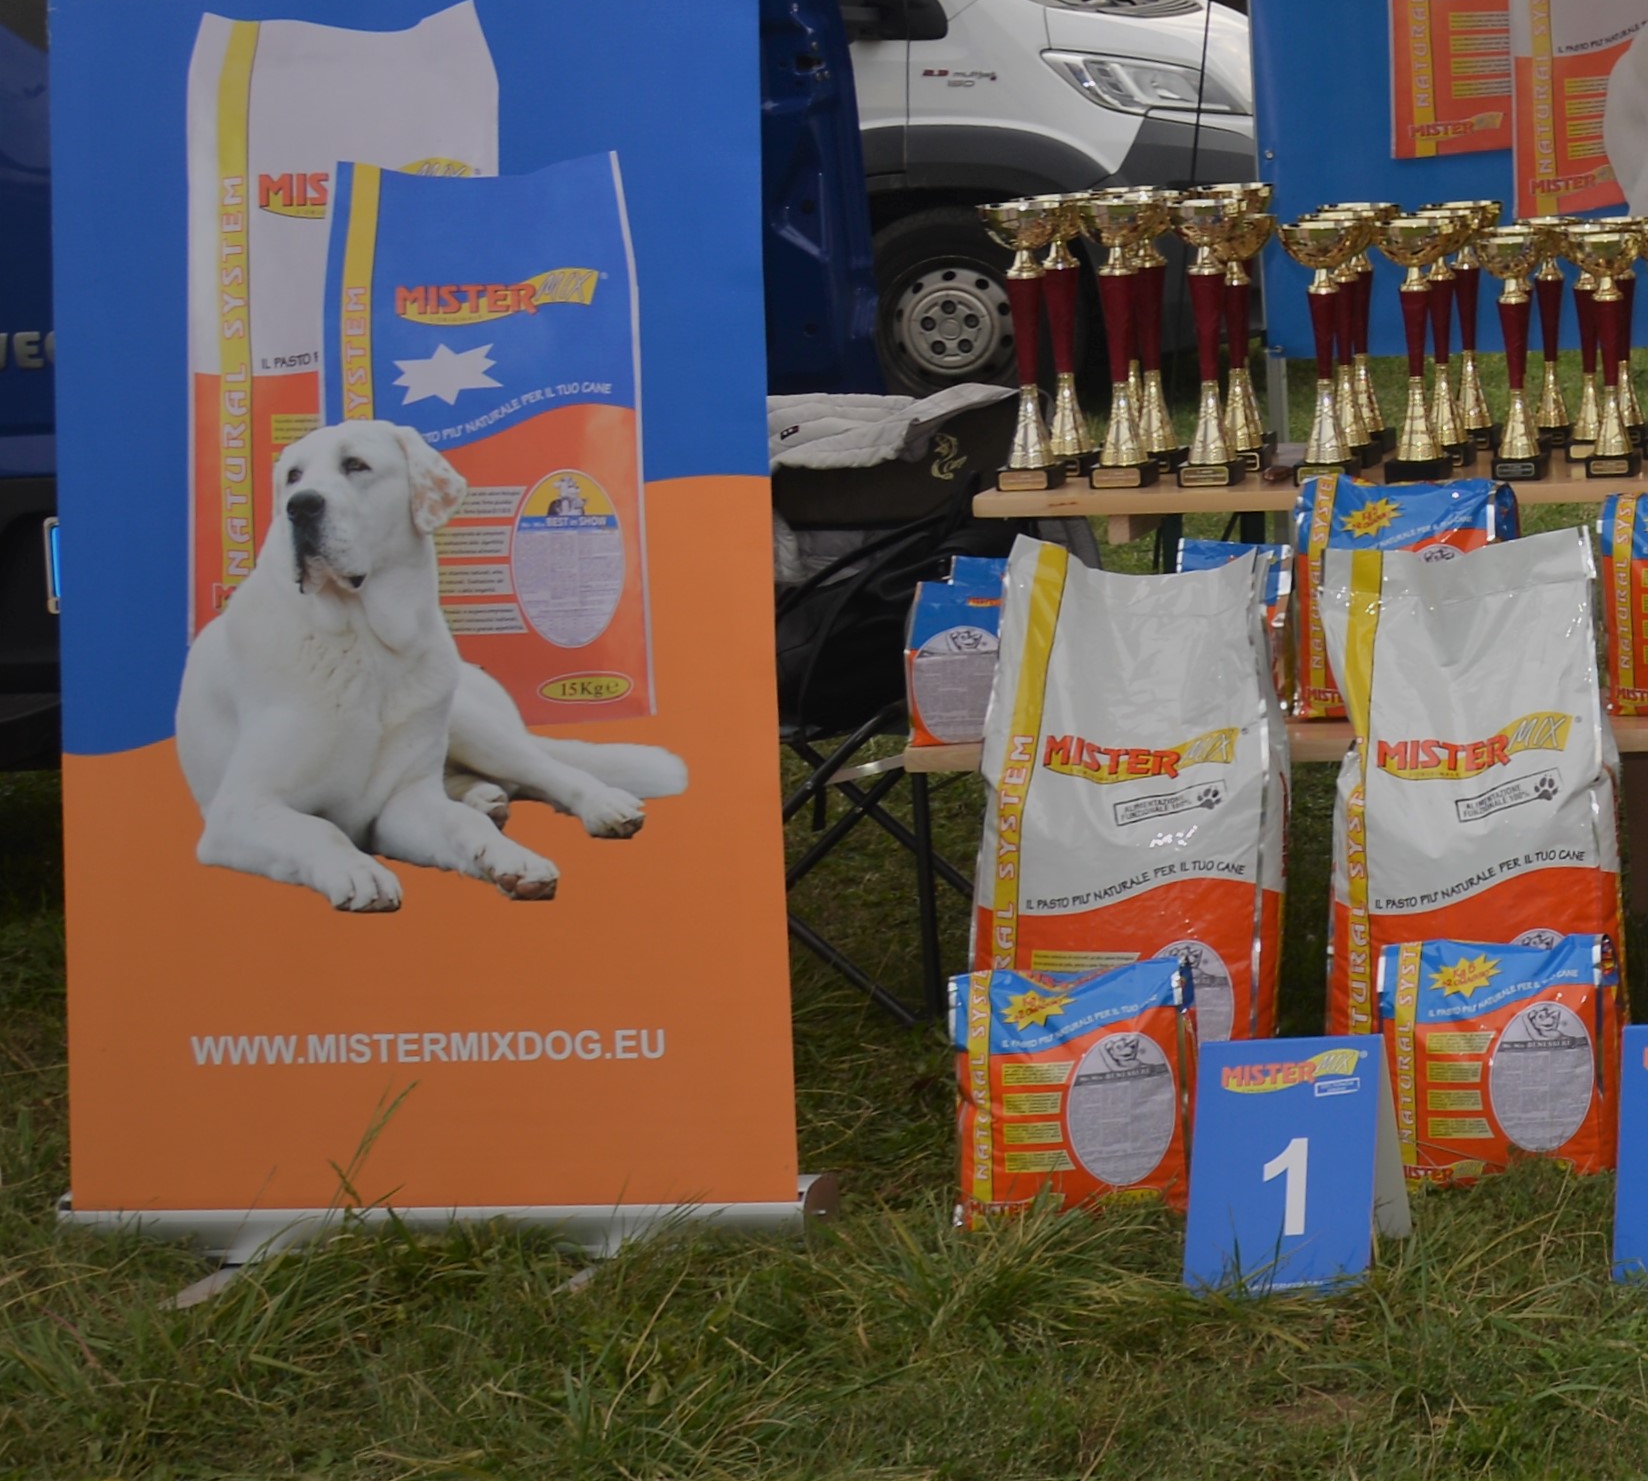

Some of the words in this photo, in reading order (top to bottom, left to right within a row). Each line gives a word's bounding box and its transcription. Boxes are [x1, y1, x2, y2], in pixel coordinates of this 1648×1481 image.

[1535, 53, 1554, 175] NATURAL
[221, 175, 246, 340] SYSTEM
[395, 283, 540, 317] MISTER
[533, 269, 592, 304] MIX
[273, 352, 312, 369] PASTO
[465, 396, 520, 434] NATURALE
[520, 389, 544, 405] PER
[555, 384, 581, 397] TUO
[581, 381, 612, 396] CANE
[1616, 557, 1631, 670] NATURAL
[1044, 734, 1181, 779] MISTER
[1376, 734, 1512, 772] MISTER
[1507, 715, 1566, 752] MIX
[999, 734, 1034, 880] SYSTEM
[1385, 897, 1418, 910] PASTO
[1441, 867, 1496, 898] NATURALE
[1499, 859, 1522, 873] PER
[1535, 849, 1557, 861] TUO
[1558, 849, 1586, 861] CANE
[191, 1028, 666, 1066] WWW.MISTERMIXDOG.EU
[1221, 1061, 1317, 1087] MISTER
[1262, 1137, 1309, 1237] 1
